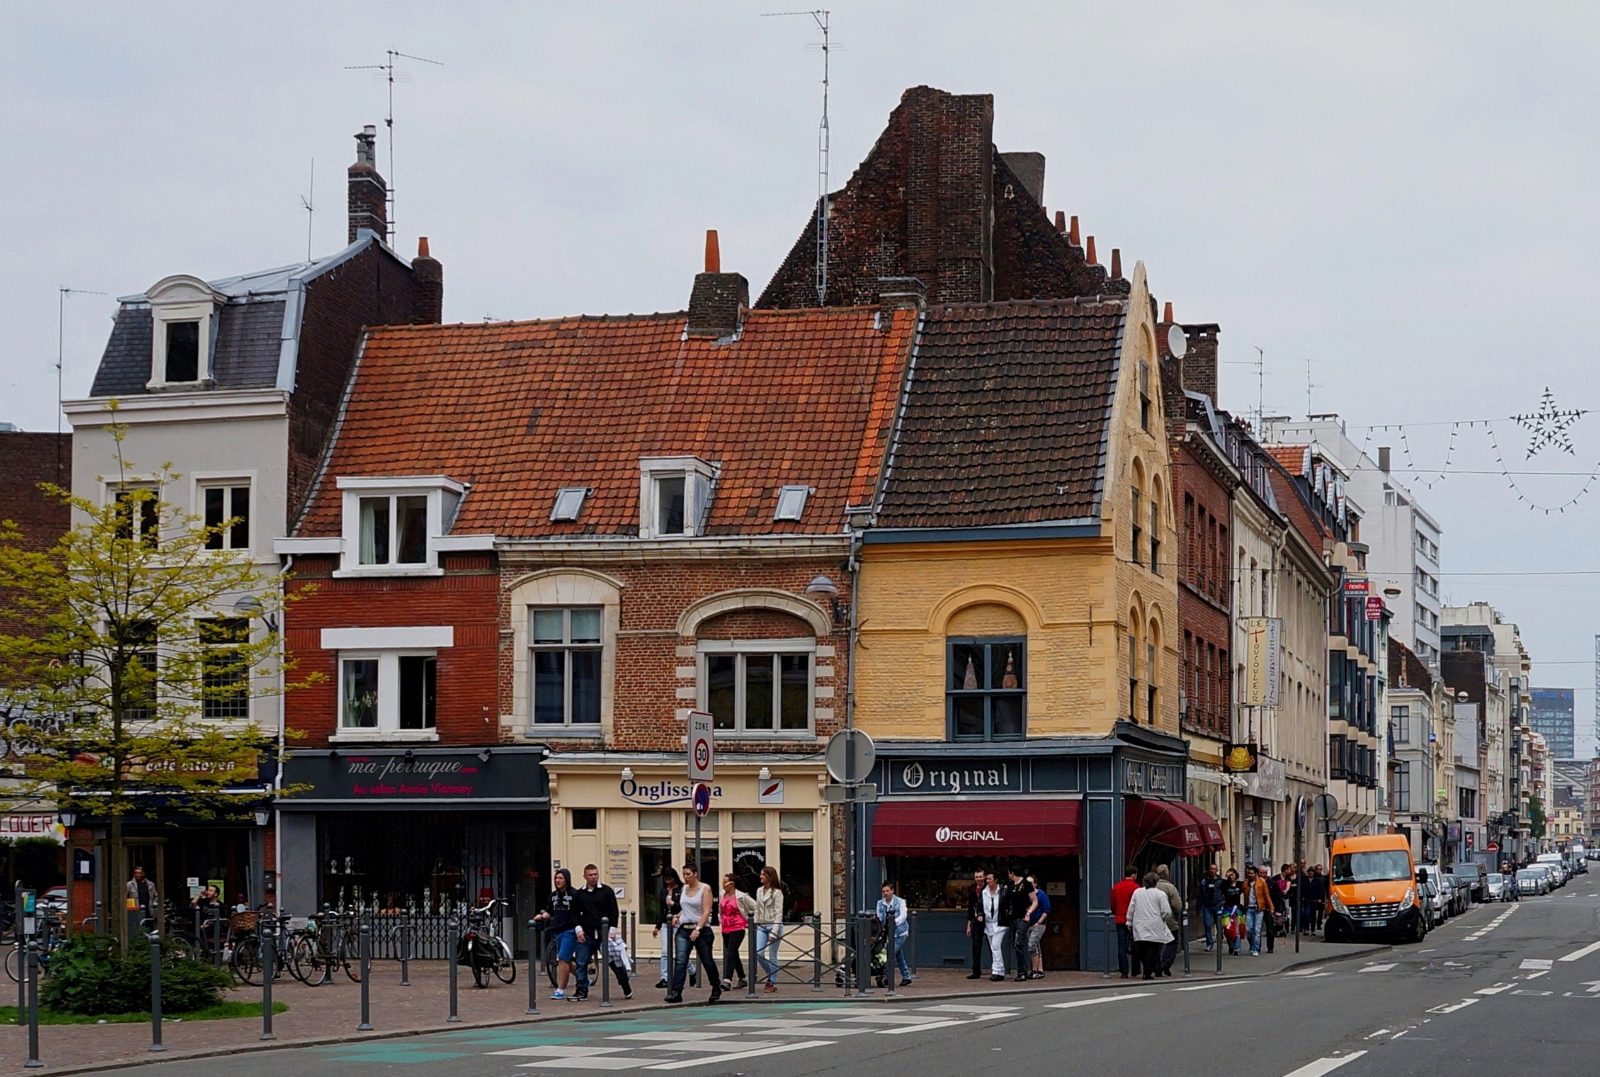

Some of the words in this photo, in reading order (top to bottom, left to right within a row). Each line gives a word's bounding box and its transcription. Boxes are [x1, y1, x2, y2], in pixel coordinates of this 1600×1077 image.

[694, 721, 709, 732] ZONE
[697, 748, 706, 762] 30
[902, 762, 1009, 793] Original
[620, 779, 723, 801] Onglissia
[935, 826, 1004, 843] ORIGINAL
